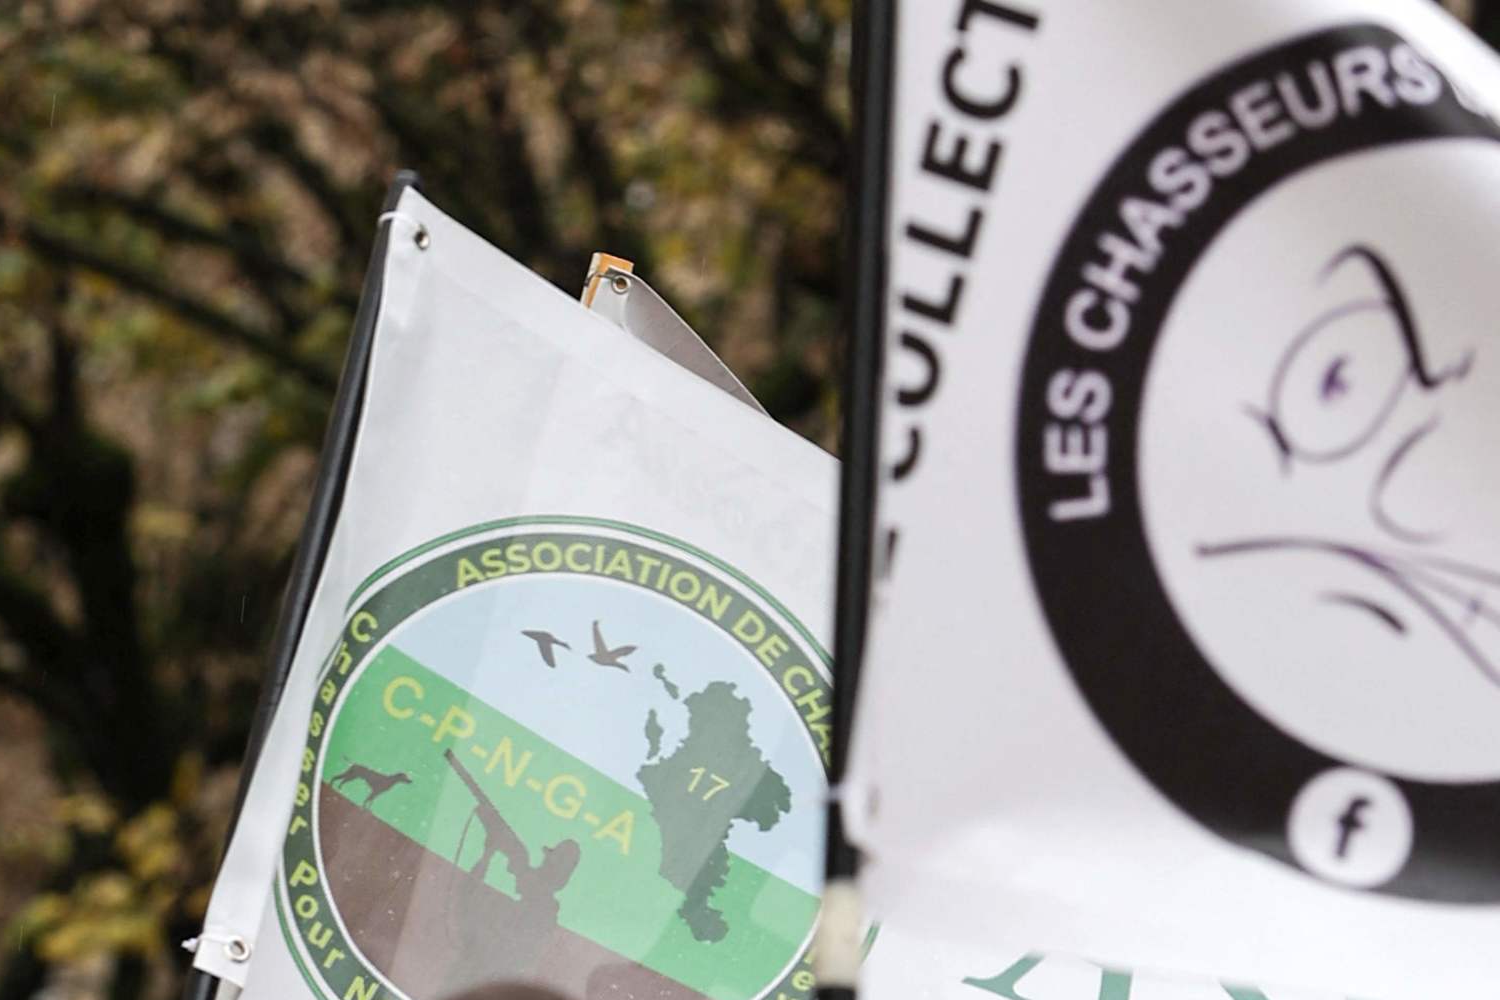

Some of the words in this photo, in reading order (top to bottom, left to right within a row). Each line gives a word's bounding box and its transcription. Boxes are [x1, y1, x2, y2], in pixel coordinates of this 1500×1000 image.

[1064, 43, 1443, 351] CHASSEURS
[1043, 367, 1113, 522] LES
[455, 540, 732, 620] ASSOCIATION
[731, 609, 790, 668] DE
[289, 611, 378, 835] Chasser
[382, 676, 636, 857] C-P-N-G-A
[687, 767, 731, 801] 17
[289, 859, 346, 969] Pour
